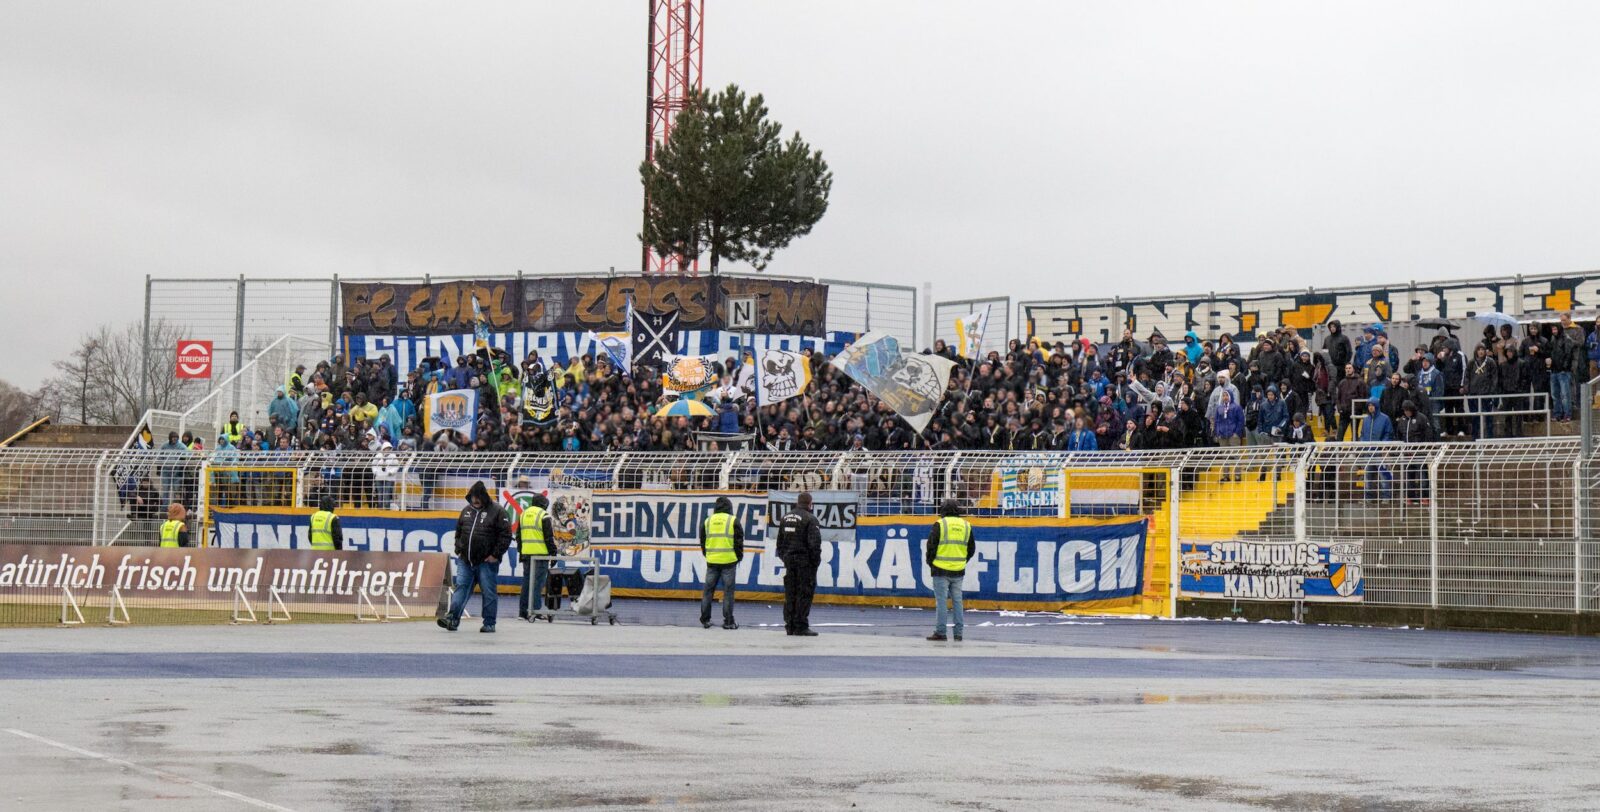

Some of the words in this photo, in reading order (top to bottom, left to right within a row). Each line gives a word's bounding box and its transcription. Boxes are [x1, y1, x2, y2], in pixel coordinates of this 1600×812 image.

[734, 301, 750, 325] N
[1030, 296, 1297, 344] ERNST
[178, 355, 210, 363] STREICHER
[1210, 541, 1326, 566] STIMMUNGS-
[0, 553, 106, 589] atürlich
[116, 553, 197, 592] frisch
[207, 556, 264, 593] und
[272, 557, 425, 598] unfiltriert!
[1223, 575, 1306, 600] KANONE
